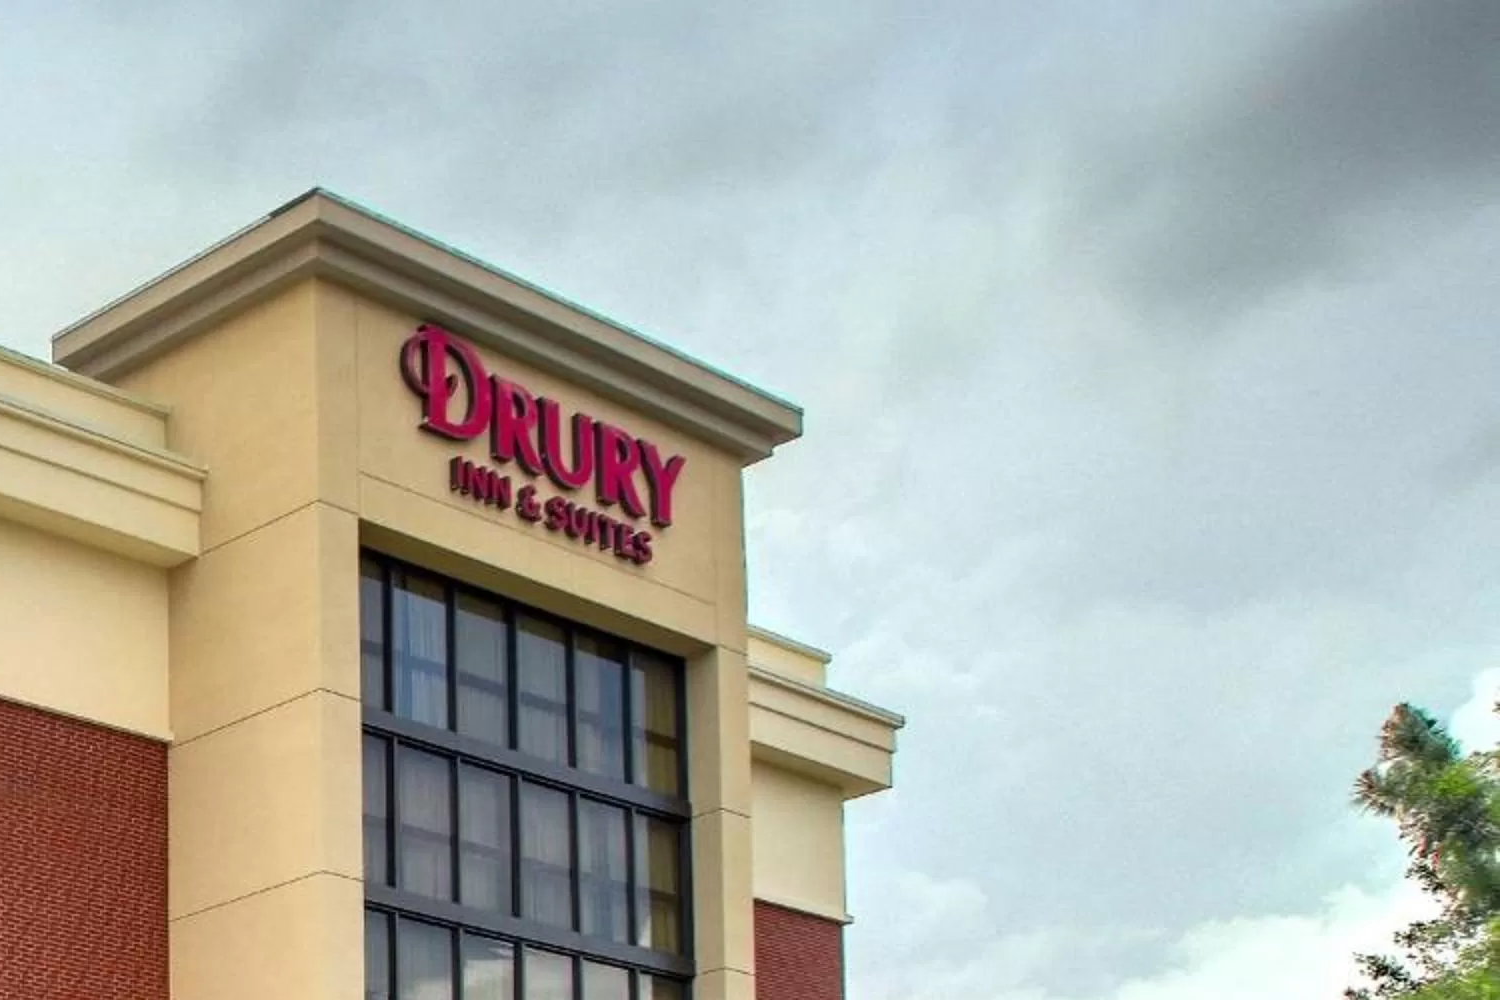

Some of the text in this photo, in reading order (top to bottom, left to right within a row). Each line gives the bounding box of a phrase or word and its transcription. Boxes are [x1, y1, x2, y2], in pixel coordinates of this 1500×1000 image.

[399, 324, 687, 528] DRURY
[450, 455, 653, 565] INN & SUITES
